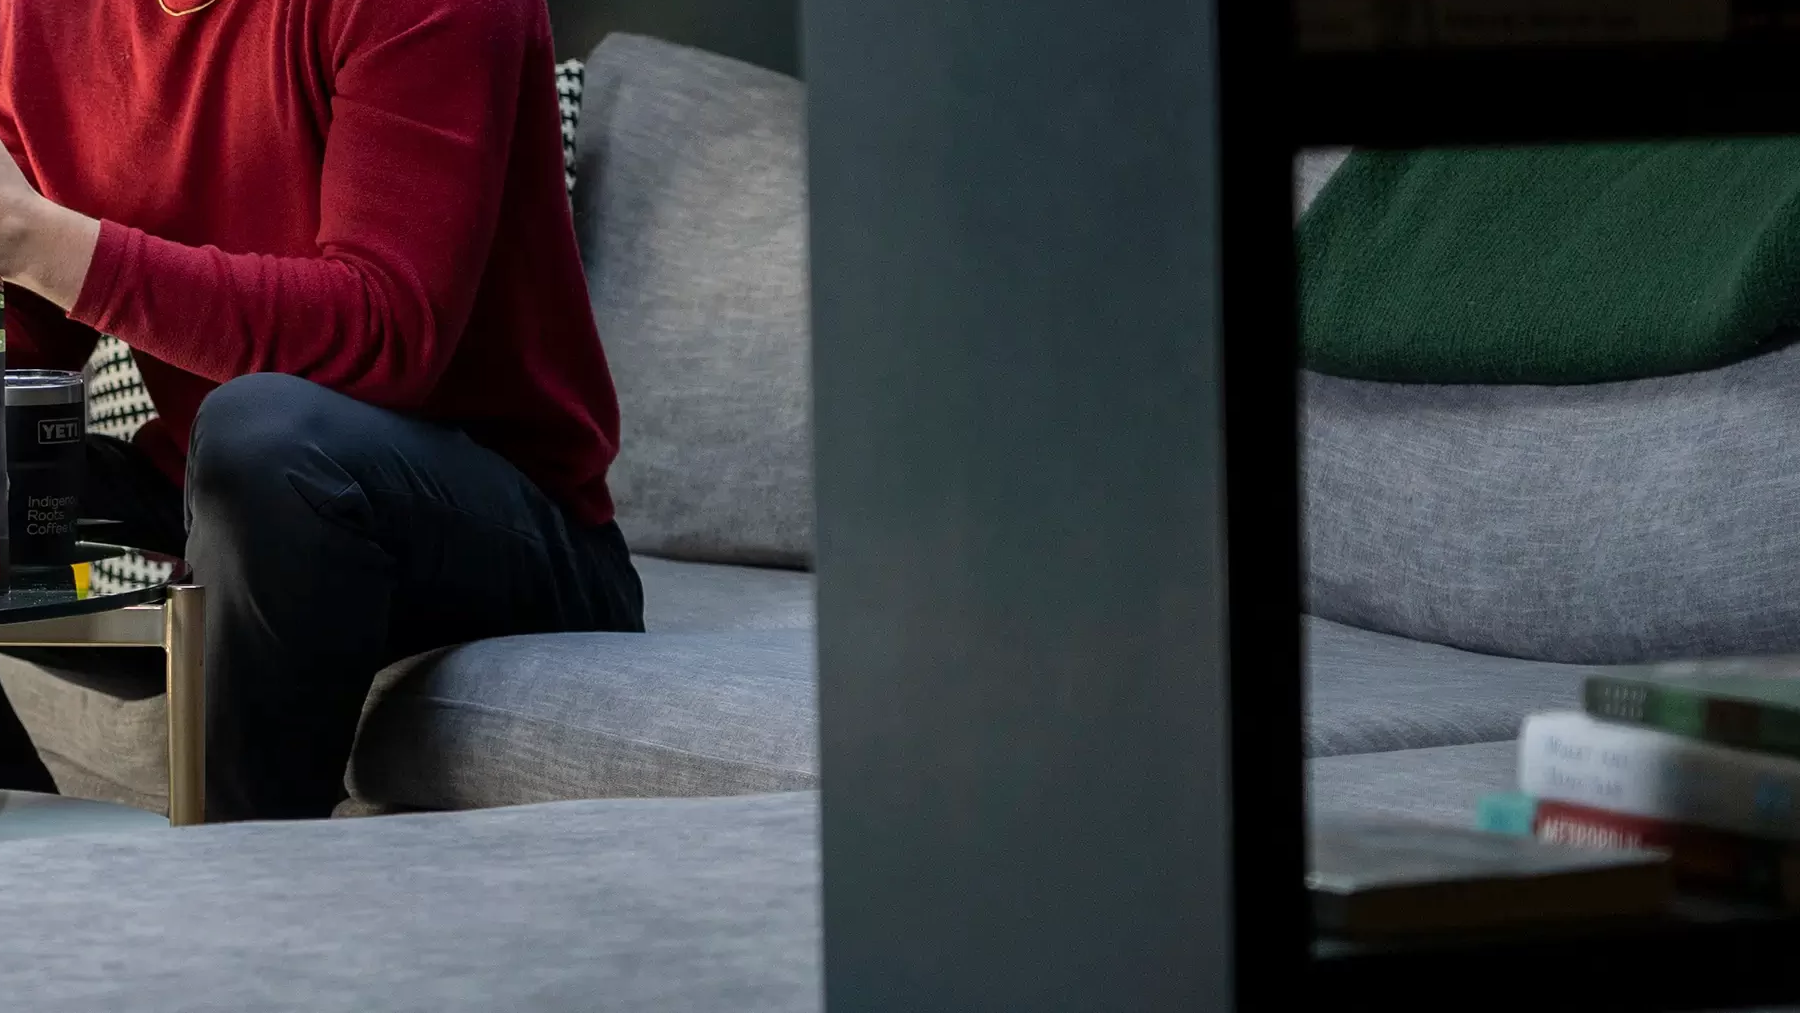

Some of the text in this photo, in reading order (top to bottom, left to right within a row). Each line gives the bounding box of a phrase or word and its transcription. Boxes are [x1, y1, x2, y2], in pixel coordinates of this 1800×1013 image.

[42, 423, 78, 439] YETI
[28, 510, 65, 521] Roots
[27, 523, 68, 535] Coffee
